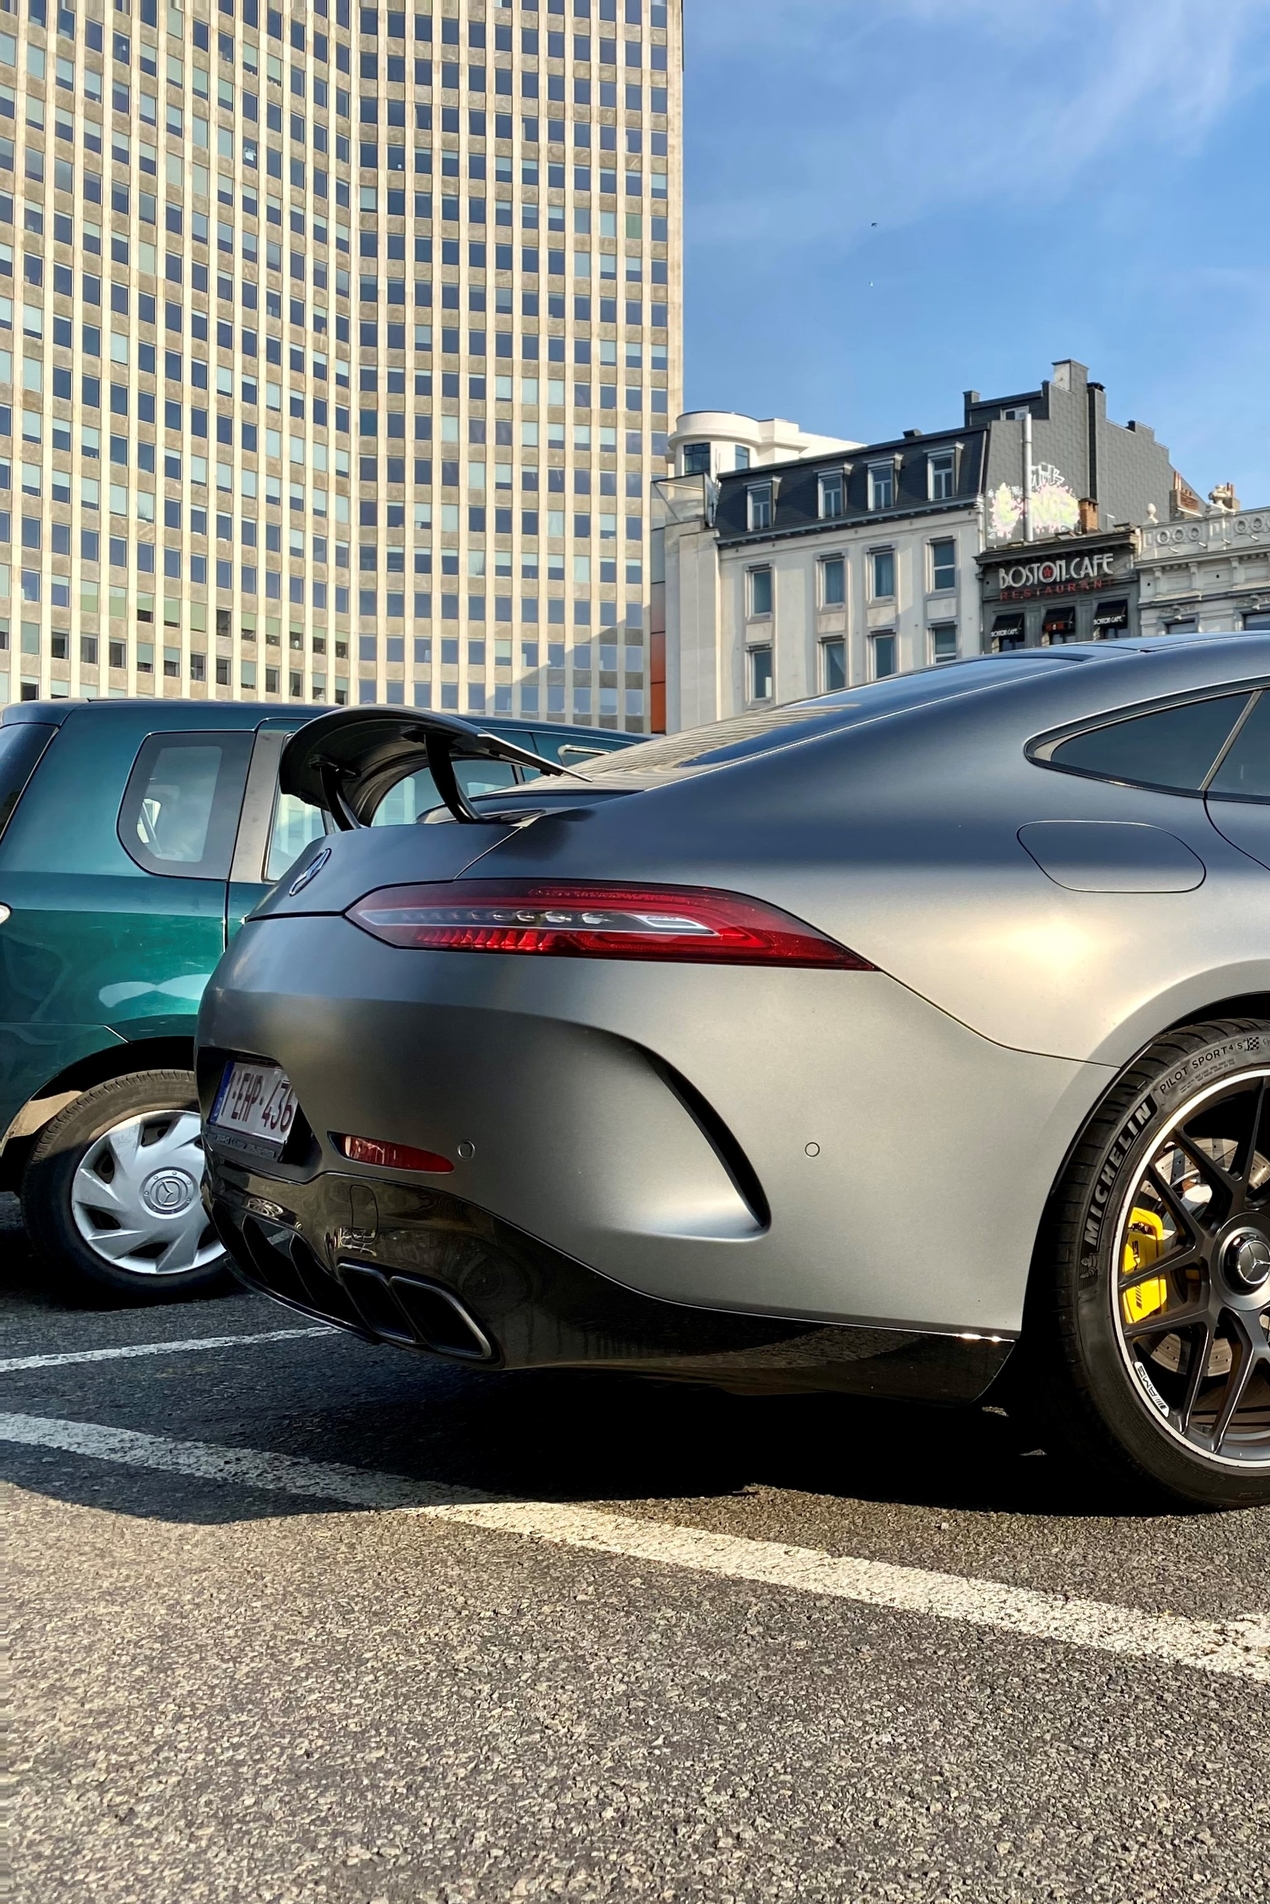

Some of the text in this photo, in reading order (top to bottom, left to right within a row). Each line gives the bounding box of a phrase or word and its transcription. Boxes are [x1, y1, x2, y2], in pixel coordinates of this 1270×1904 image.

[998, 552, 1114, 590] BOSTON CAFE
[1000, 577, 1116, 601] RESTAURANT
[1158, 1064, 1188, 1095] PILOT
[1084, 1101, 1152, 1247] MICHELIN
